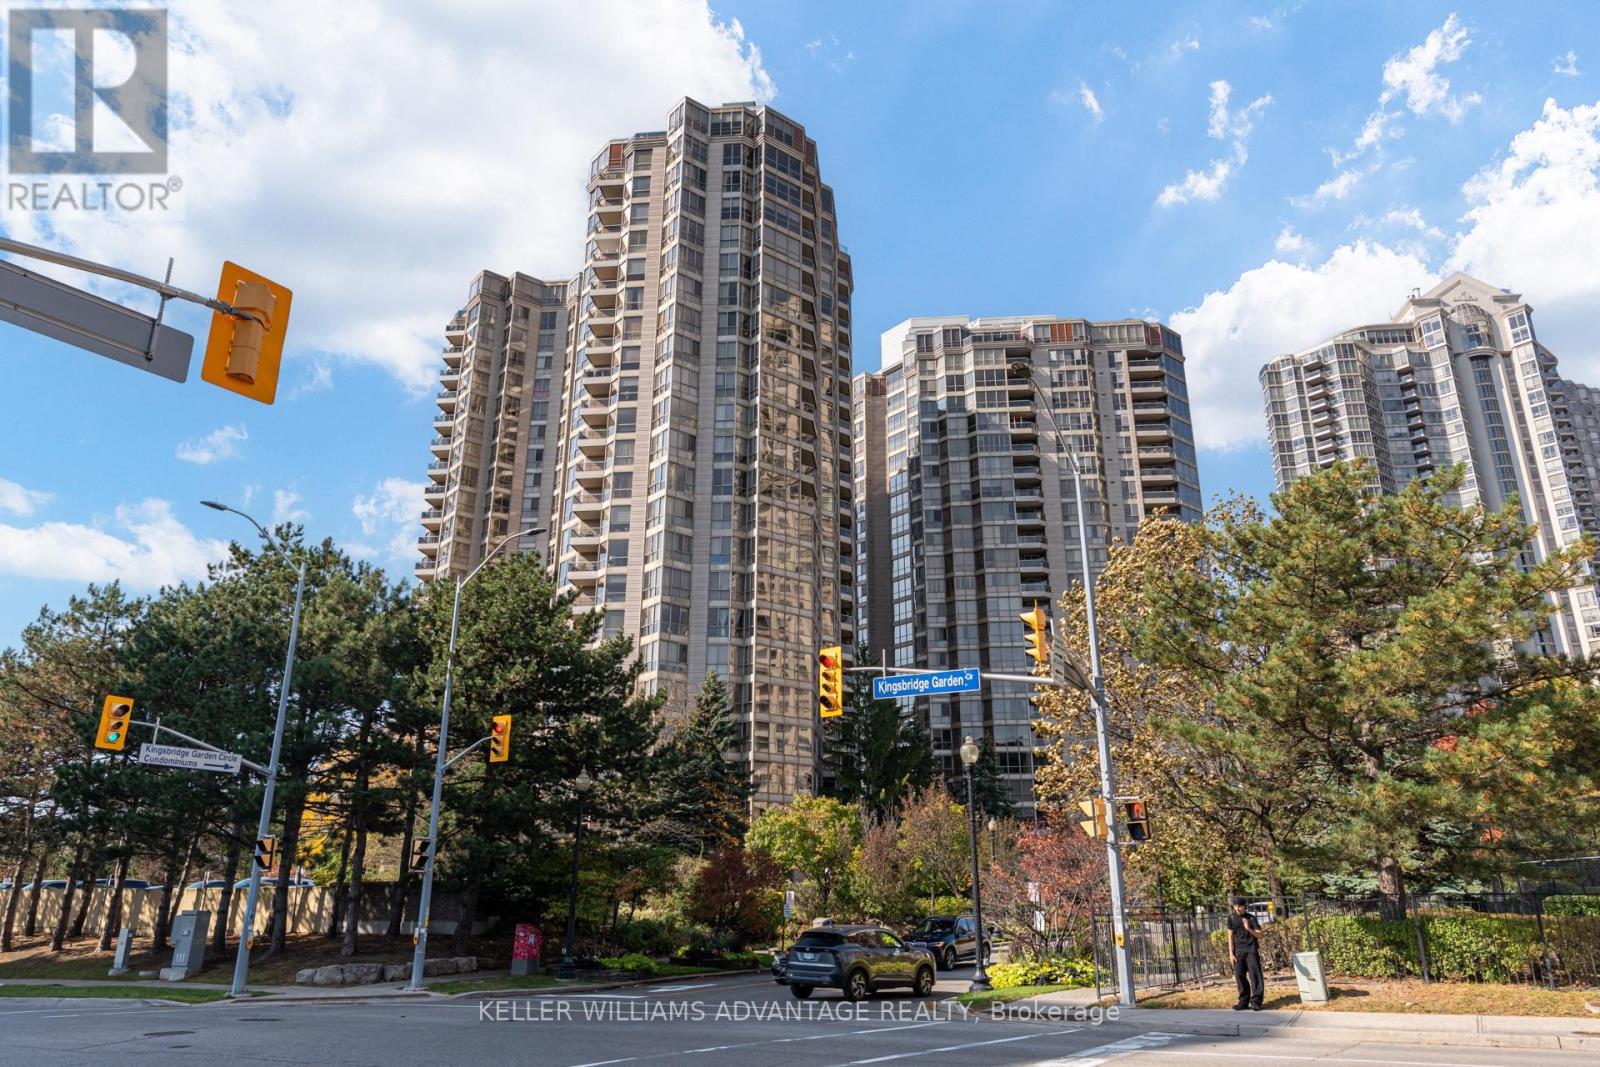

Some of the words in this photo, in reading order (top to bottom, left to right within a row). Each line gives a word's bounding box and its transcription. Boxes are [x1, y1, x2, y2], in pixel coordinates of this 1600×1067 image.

[878, 679, 929, 694] Kingsbridge
[931, 676, 963, 688] Garden
[144, 755, 198, 766] Condominiums
[145, 744, 190, 759] Kingsbridge
[191, 750, 217, 760] Garden
[218, 753, 238, 762] Circle
